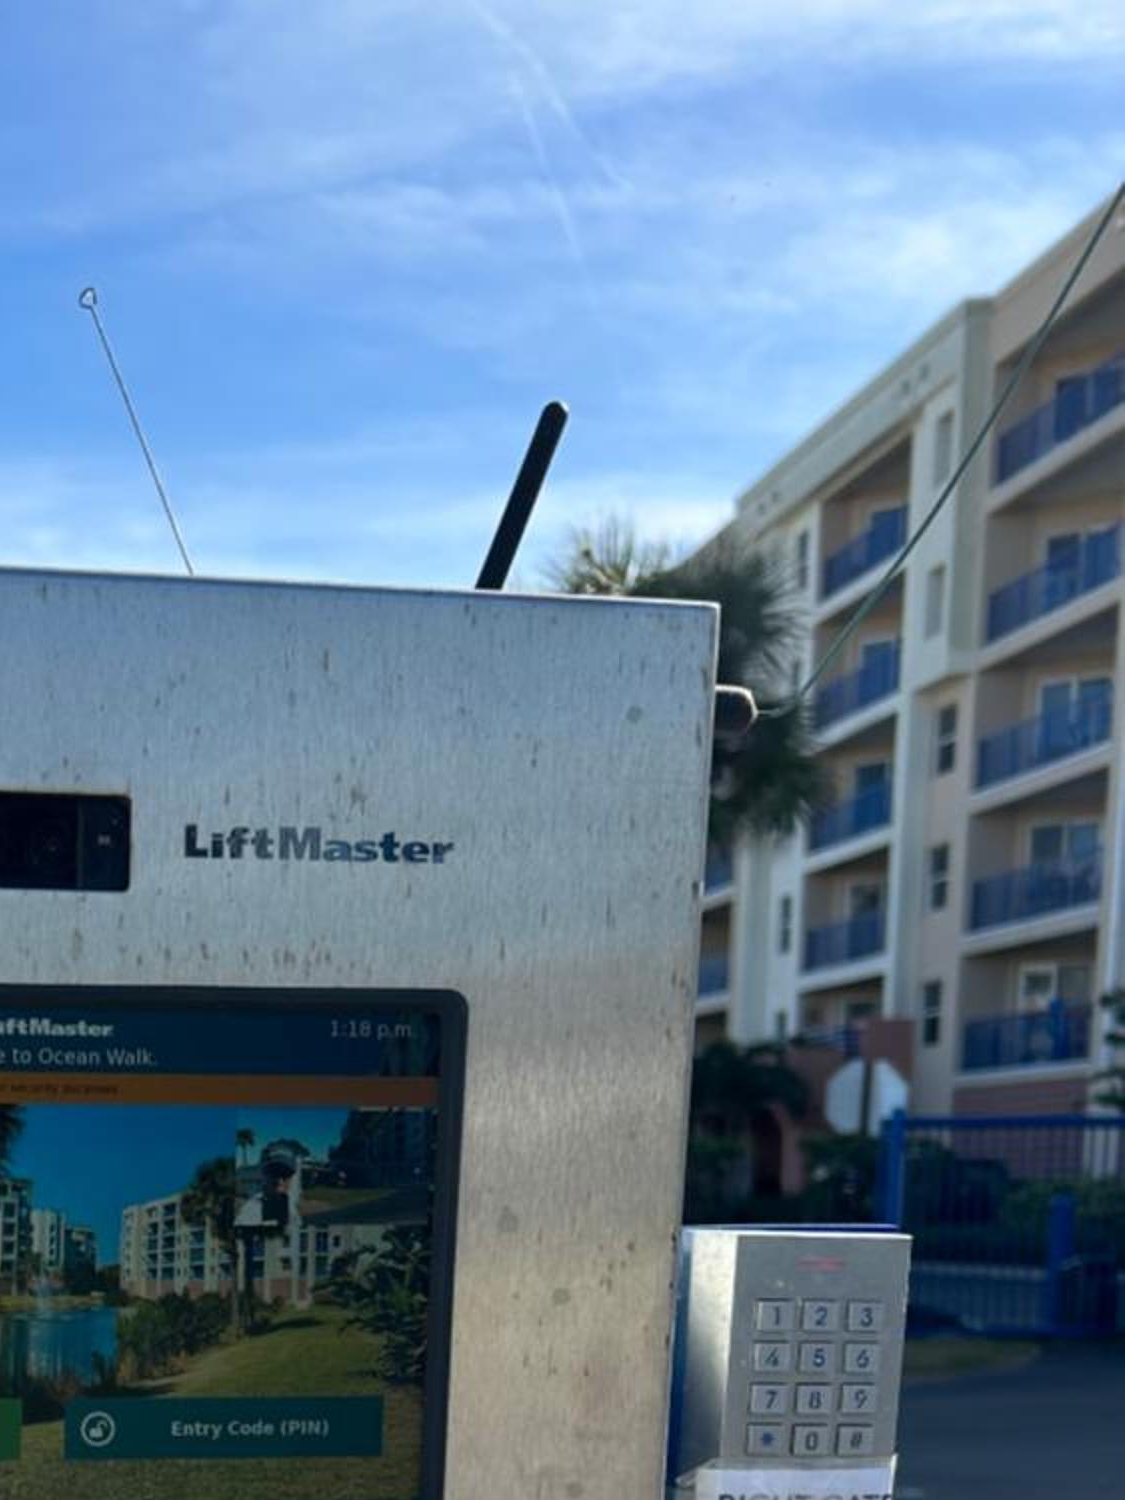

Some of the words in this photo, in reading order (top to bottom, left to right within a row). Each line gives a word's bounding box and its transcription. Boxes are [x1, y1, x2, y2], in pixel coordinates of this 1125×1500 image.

[184, 824, 455, 863] LiftMaster
[331, 1019, 372, 1038] 1:18
[12, 1047, 32, 1064] to
[38, 1047, 100, 1065] Ocean
[772, 1306, 782, 1325] 1
[815, 1308, 829, 1327] 2
[860, 1309, 873, 1328] 3
[764, 1348, 780, 1366] 4
[813, 1348, 826, 1367] 5
[856, 1349, 870, 1368] 6
[765, 1391, 778, 1410] 7
[809, 1391, 822, 1410] 8
[854, 1391, 868, 1410] 9
[172, 1421, 221, 1440] Entry
[227, 1421, 274, 1437] Code
[280, 1420, 330, 1438] (PIN)
[805, 1431, 819, 1451] 0
